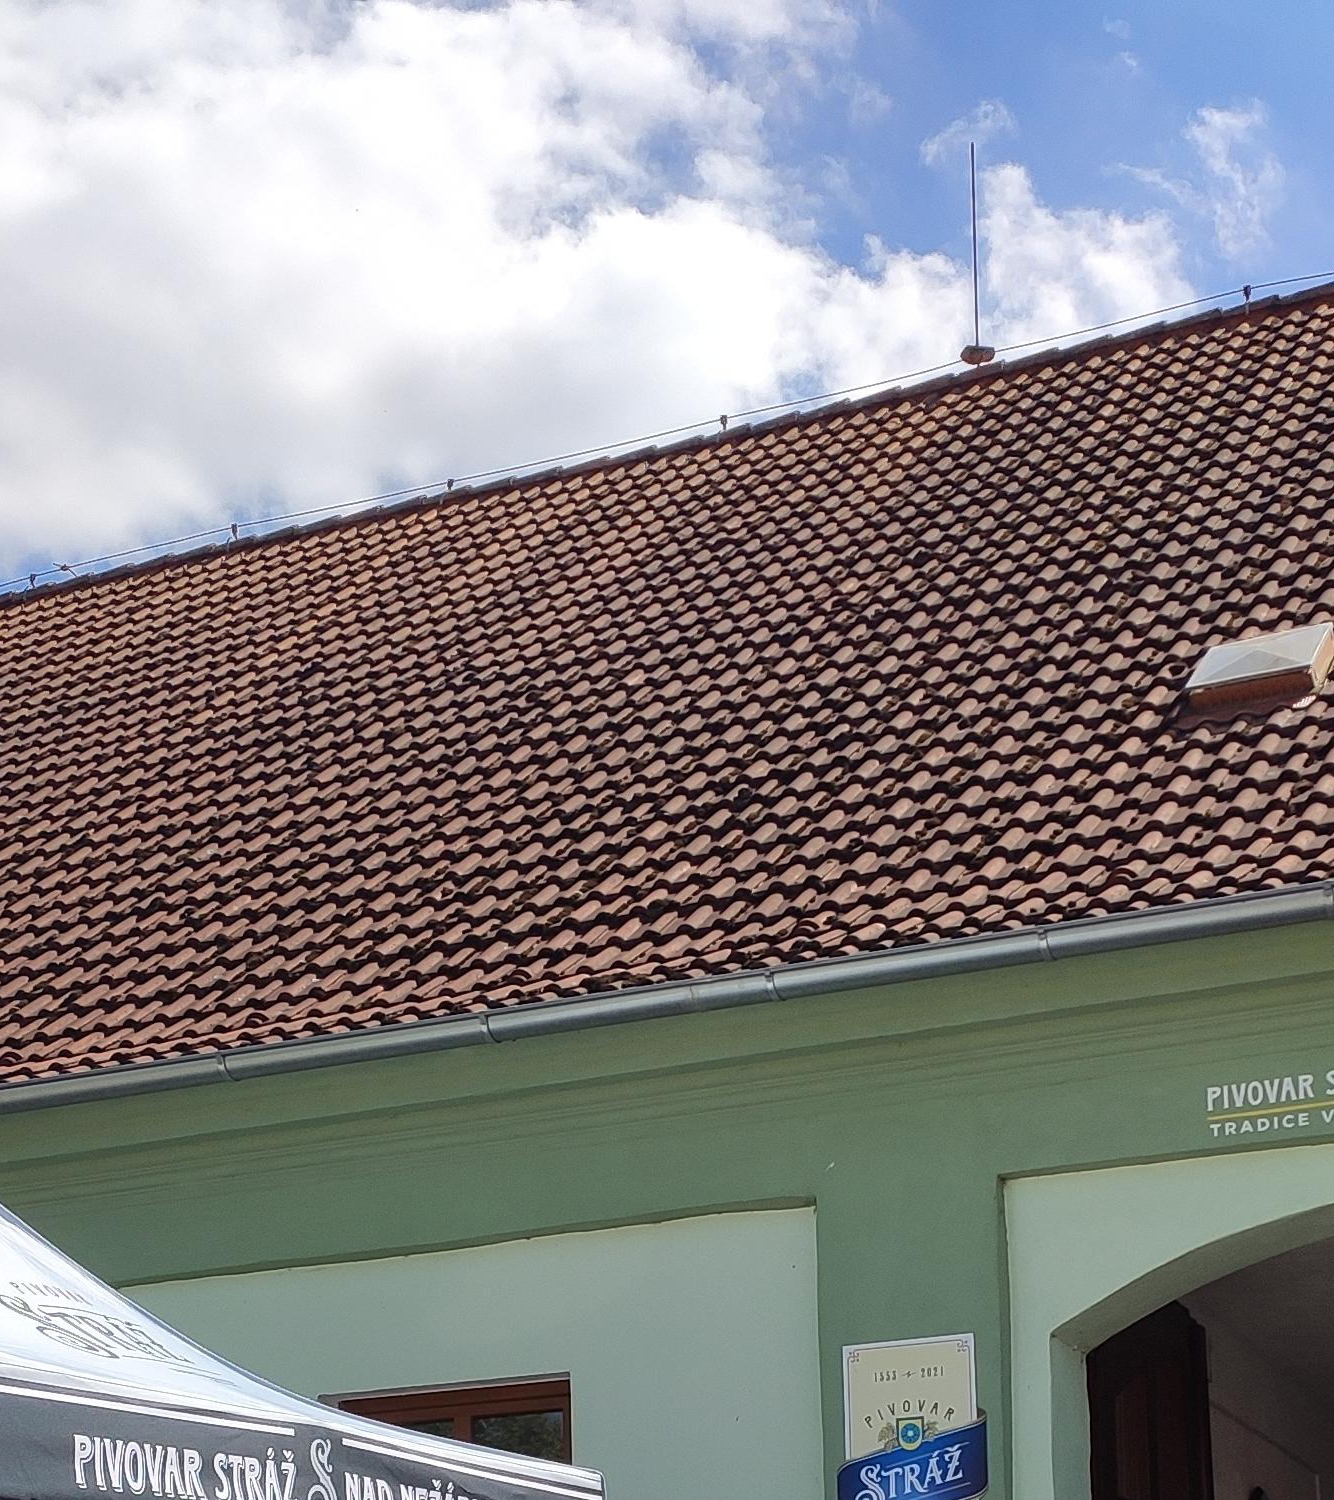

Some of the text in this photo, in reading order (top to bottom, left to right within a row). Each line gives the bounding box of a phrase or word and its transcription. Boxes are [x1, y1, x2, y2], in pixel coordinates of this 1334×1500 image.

[1206, 1074, 1315, 1112] PIVOVAR
[1210, 1110, 1311, 1138] TRADICE
[920, 1366, 945, 1378] 2021
[864, 1400, 955, 1429] PIVOVAR
[73, 1434, 204, 1499] PIVOVAR
